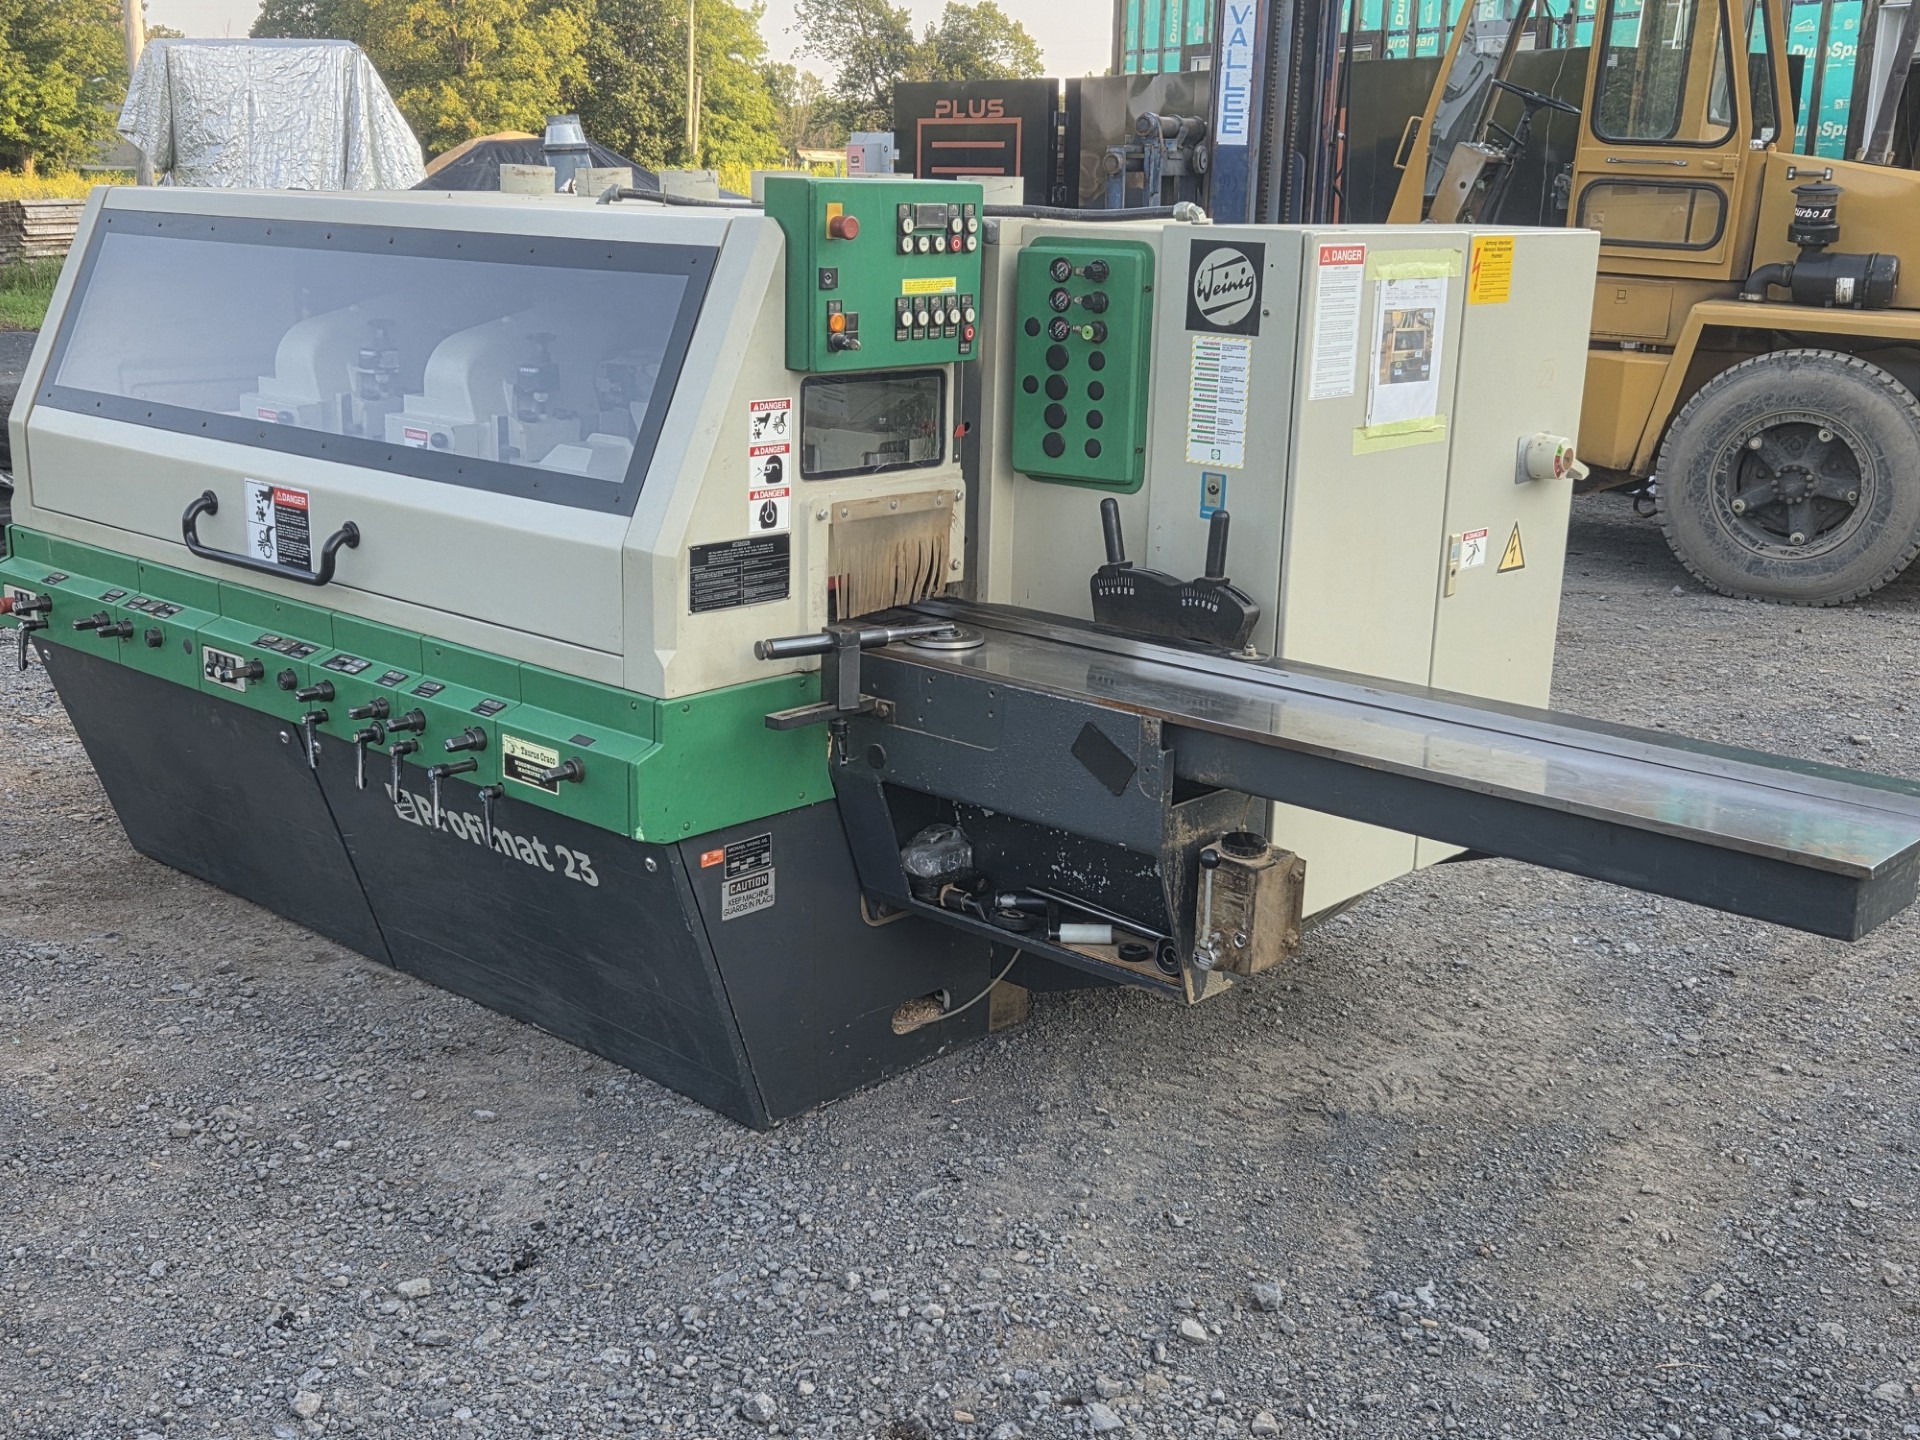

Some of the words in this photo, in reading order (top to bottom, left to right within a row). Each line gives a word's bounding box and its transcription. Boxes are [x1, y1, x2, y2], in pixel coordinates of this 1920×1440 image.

[1222, 5, 1250, 134] VALLEE
[935, 99, 1004, 118] PLUS
[1331, 249, 1362, 261] DANGER
[1197, 262, 1255, 302] Weinig
[760, 401, 787, 411] DANGER
[760, 444, 786, 455] DANGER
[281, 492, 306, 506] DANGER
[759, 488, 785, 499] DANGER
[555, 844, 599, 887] 23
[730, 875, 768, 894] CAUTION
[723, 902, 748, 917] GUARDS
[755, 894, 774, 906] PLACE
[728, 896, 743, 907] KEEP
[742, 888, 769, 903] MACHINE
